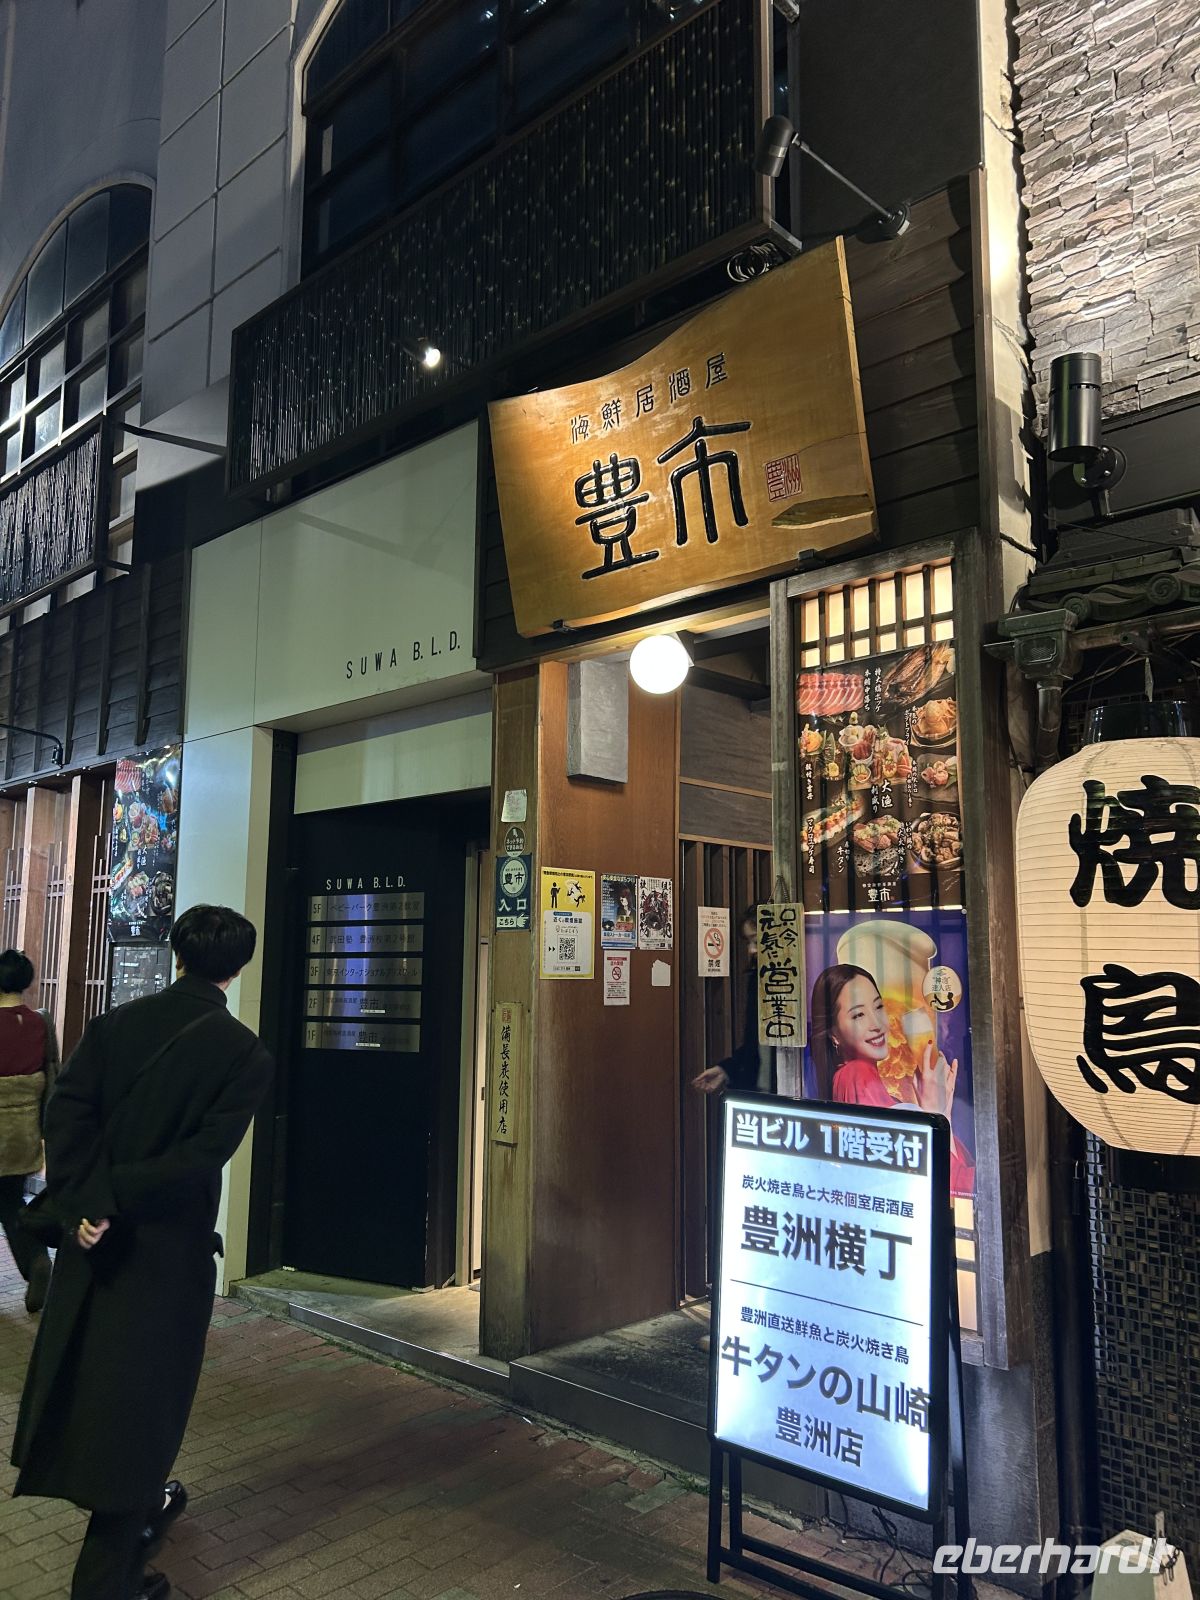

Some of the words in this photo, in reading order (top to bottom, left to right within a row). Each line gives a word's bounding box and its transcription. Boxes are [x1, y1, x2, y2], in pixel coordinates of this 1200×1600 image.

[570, 352, 728, 444] 海鮮居酒屋
[573, 415, 752, 580] 豊市
[346, 647, 397, 679] SUWA
[413, 630, 461, 661] B.L.D.
[881, 778, 893, 809] 大漁
[325, 877, 364, 891] SUWA
[373, 875, 406, 889] B.L.D.
[502, 872, 525, 887] 豊市
[312, 903, 322, 914] 5F
[497, 917, 515, 926] こちら
[498, 898, 527, 912] 入口
[311, 934, 321, 944] 4F
[1068, 774, 1200, 1106] 焼鳥
[310, 966, 319, 977] 3F
[308, 998, 318, 1009] 2F
[759, 957, 798, 1039] 営業中
[307, 1029, 316, 1041] 1F
[736, 1113, 810, 1151] 当ビル
[819, 1124, 922, 1169] 1階受付
[742, 1174, 914, 1218] 炭火焼き鳥と大衆個室居酒屋
[740, 1205, 913, 1281] 豊洲横丁
[740, 1306, 909, 1365] 豊洲直送鮮魚と炭火焼き鳥
[721, 1335, 930, 1433] 牛タンの山崎
[775, 1405, 864, 1468] 豊洲店
